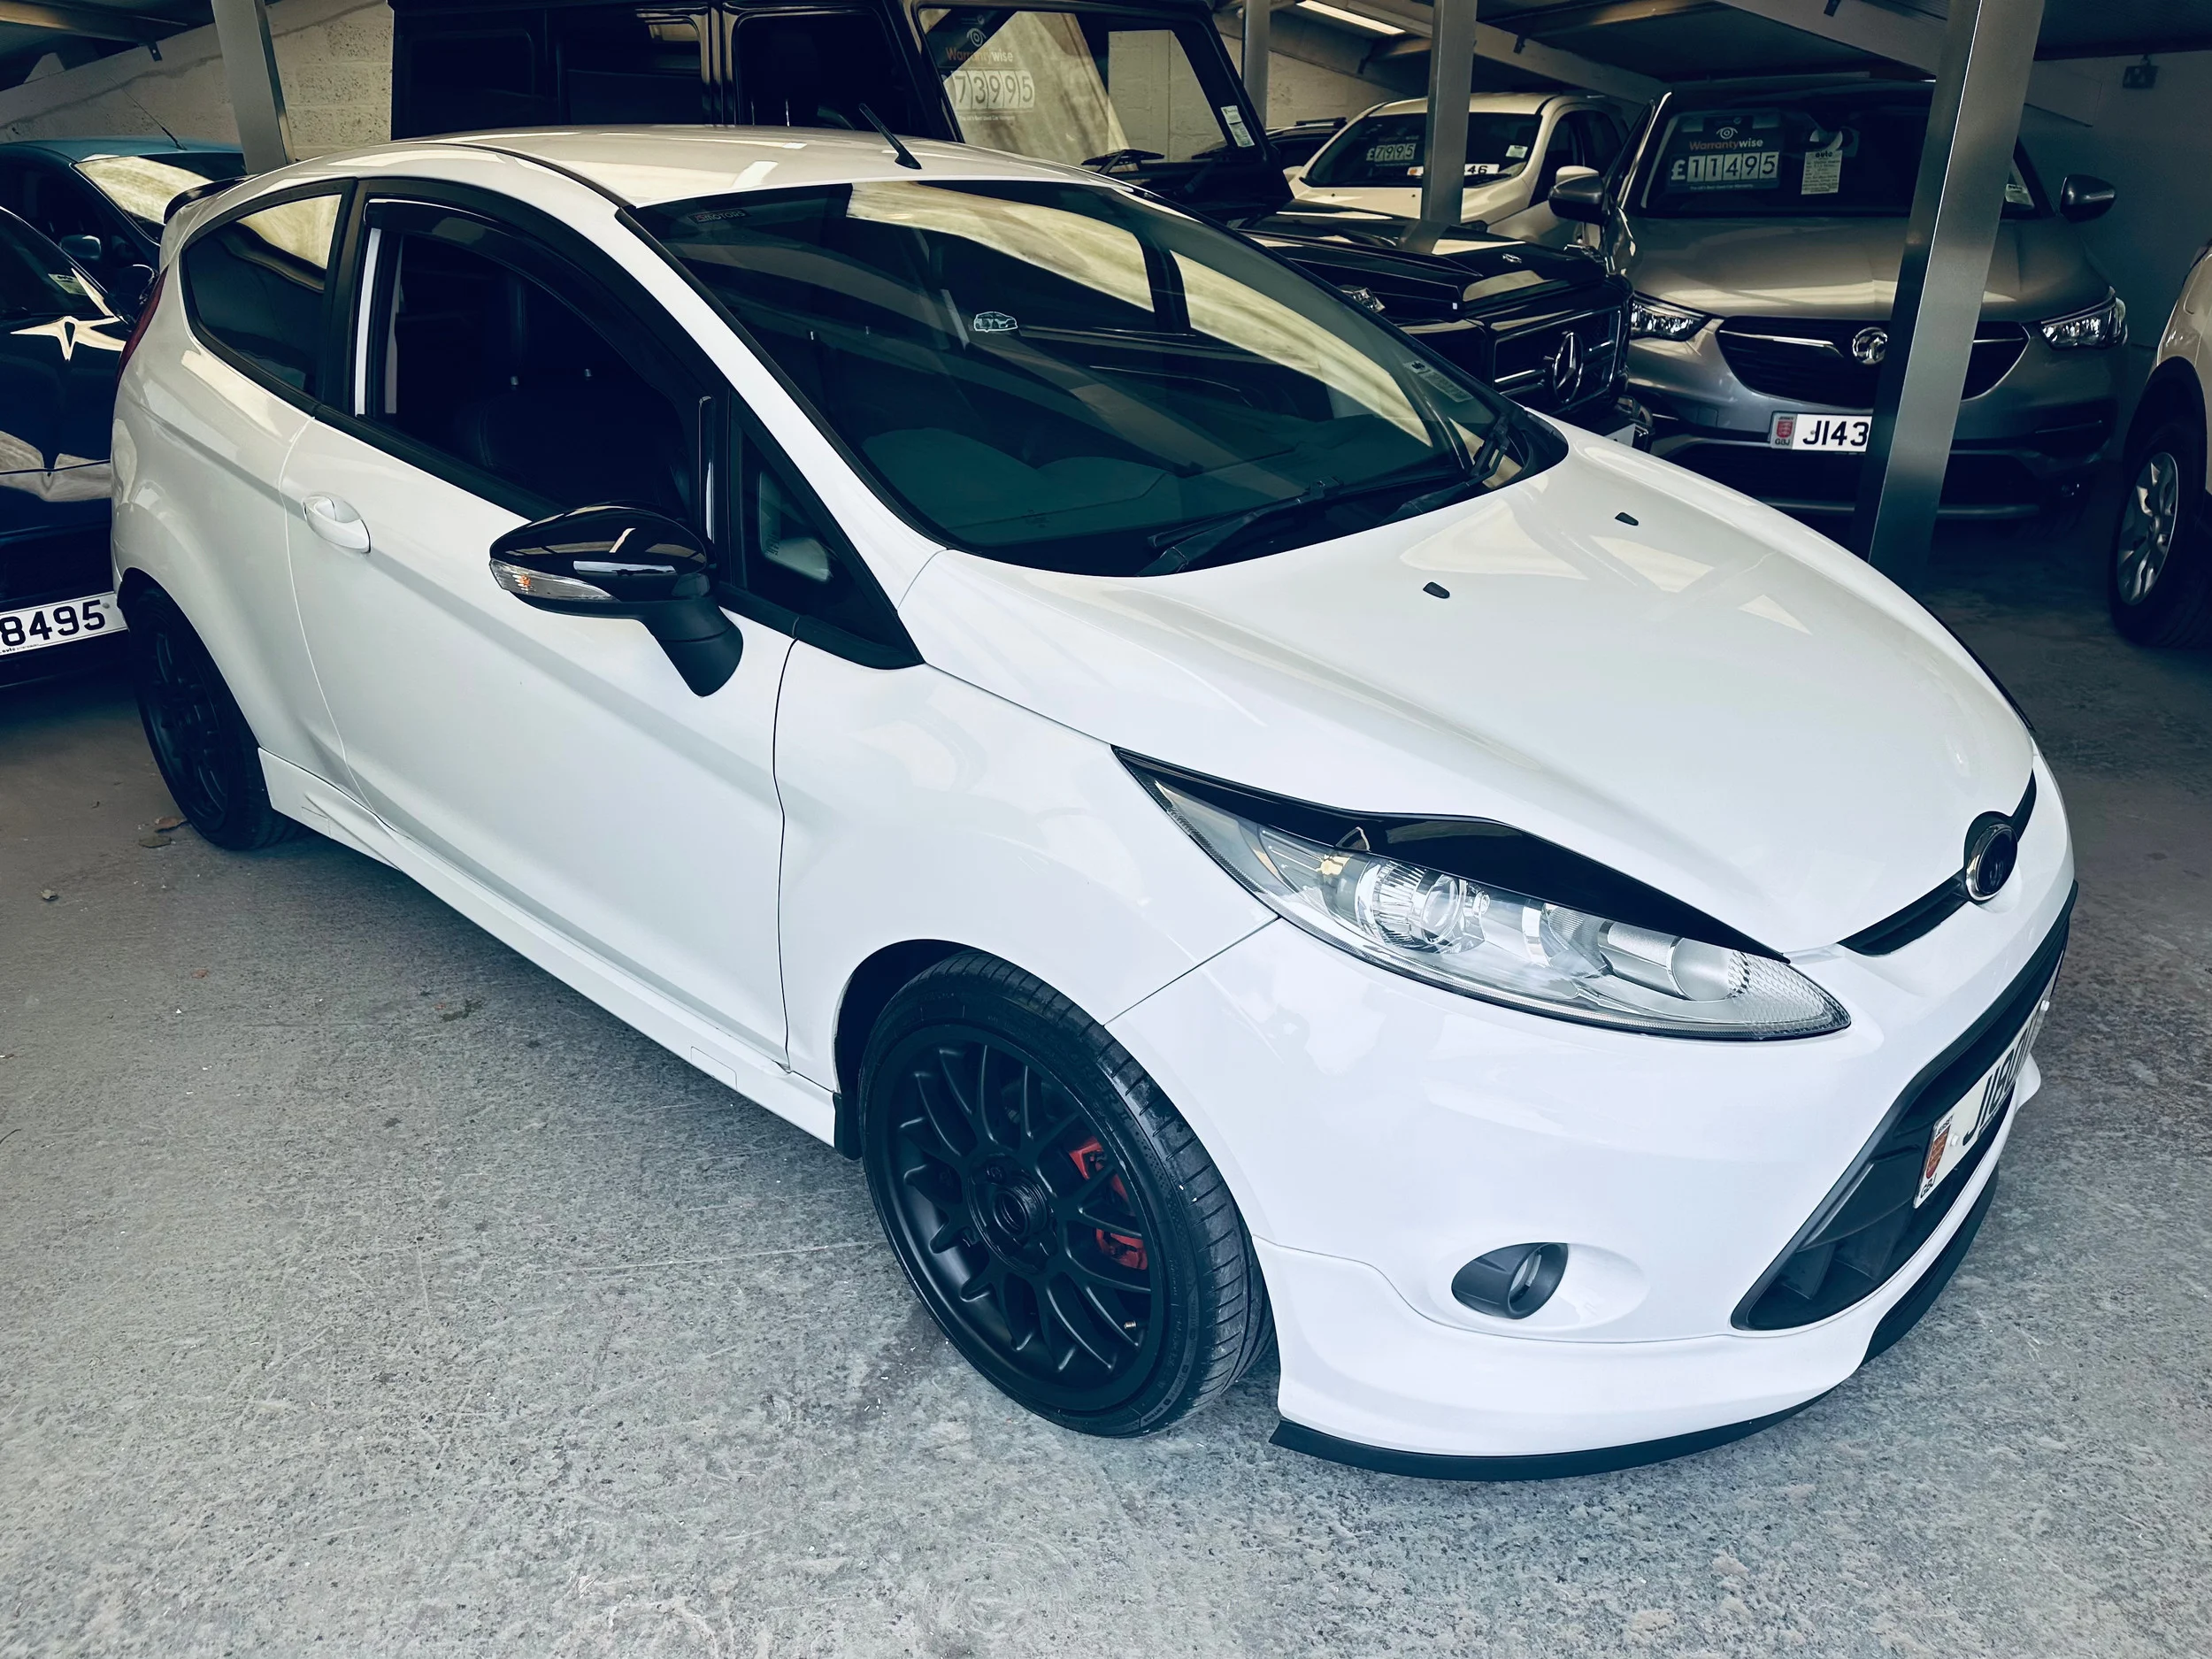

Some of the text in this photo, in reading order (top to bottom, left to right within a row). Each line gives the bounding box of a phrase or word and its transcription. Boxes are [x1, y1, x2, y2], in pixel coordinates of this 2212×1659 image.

[946, 47, 1013, 64] Warrantywise
[1366, 144, 1414, 161] £7995
[1689, 137, 1763, 150] Warrantywise
[1671, 155, 1776, 180] £11495
[1802, 420, 1870, 446] J143
[0, 599, 105, 646] 8495
